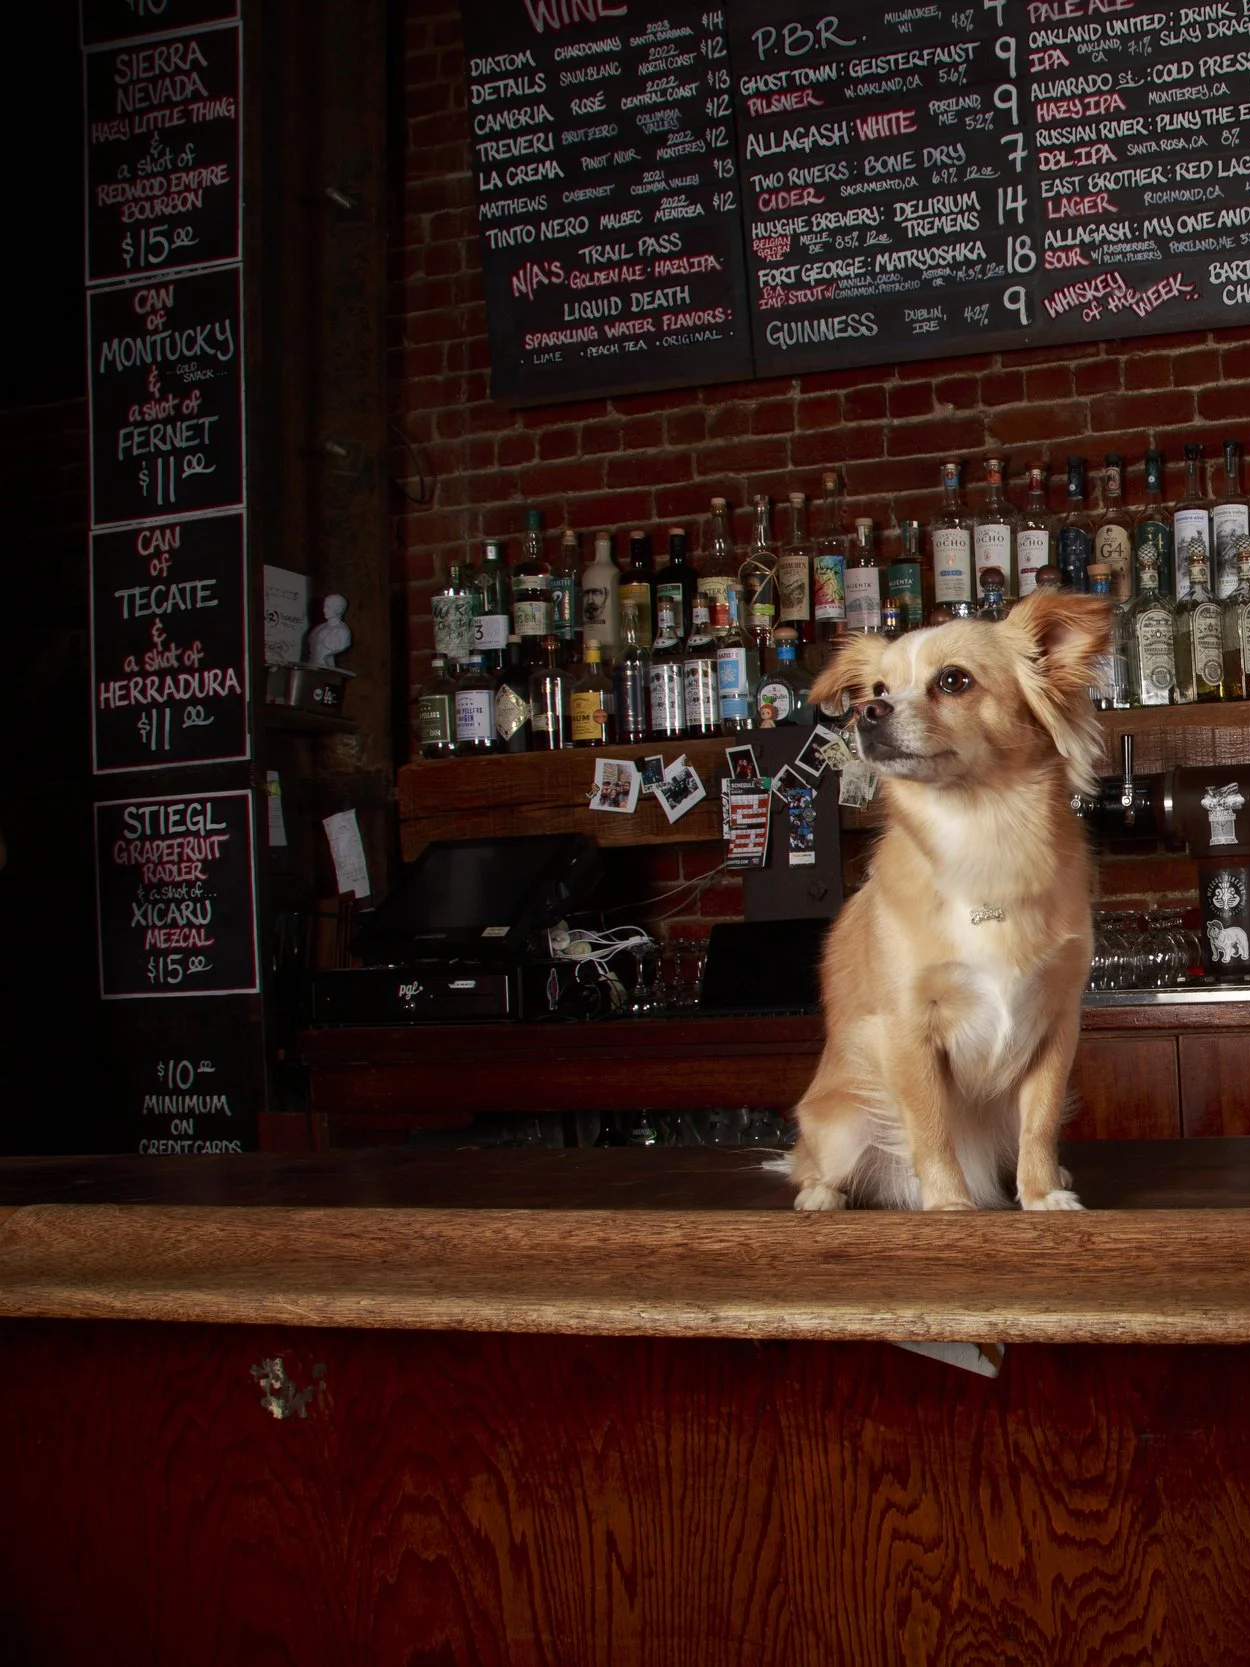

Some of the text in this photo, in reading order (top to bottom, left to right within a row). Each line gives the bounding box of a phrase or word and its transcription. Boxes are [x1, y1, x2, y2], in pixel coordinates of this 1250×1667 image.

[1028, 11, 1166, 49] OAKLAND UNITED
[1159, 26, 1201, 47] SLAY
[114, 42, 208, 84] SIERRA
[470, 49, 536, 78] DIATOM
[850, 41, 981, 78] GEISTERFAUST
[1028, 47, 1070, 73] IPA
[117, 72, 209, 114] NEVADA
[470, 72, 548, 105] DETAILS
[1030, 71, 1113, 102] ALVARADO
[1152, 61, 1195, 84] COLD
[92, 98, 235, 144] HAZY LITTLE THING
[472, 103, 555, 136] CAMBRIA
[854, 109, 918, 142] WHITE
[1202, 104, 1237, 126] THE
[138, 143, 196, 176] shot of
[656, 139, 706, 161] MONTEREY
[479, 148, 642, 192] LA CREMA PINOT NOIR
[750, 142, 967, 192] TWO BONE DRY
[1040, 174, 1087, 199] EAST
[1175, 162, 1214, 181] RED
[97, 164, 230, 207] REDWOOD EMPIRE
[757, 186, 826, 213] CIDER
[122, 190, 204, 223] BOURBON
[478, 194, 548, 222] MATTHEWS
[654, 203, 705, 224] MENDOZA
[751, 190, 981, 240] HUYGHE DELIRIUM
[1047, 192, 1120, 220] LAGER
[485, 209, 644, 250] TINTO NERO MALBEC
[901, 211, 980, 240] TREMENS
[1143, 211, 1217, 239] MY ONE
[578, 232, 683, 267] TRAIL PASS
[757, 240, 988, 289] FORT MATRYOSHKA
[1043, 248, 1090, 270] SOUR
[134, 283, 175, 315] CAN
[563, 284, 691, 322] LIQUID DEATH
[788, 283, 824, 305] STOUT
[1042, 271, 1128, 320] WHISKEY
[146, 310, 168, 329] of
[1082, 304, 1105, 323] of
[99, 318, 235, 374] MONTUCKY
[524, 318, 656, 350] SPARKLING WATER
[766, 311, 880, 351] GUINNESS
[533, 330, 724, 366] LIME TEA ORIGINAL
[143, 390, 203, 422] shot of
[117, 415, 220, 460] FERNET
[137, 526, 181, 557] CAN
[936, 539, 967, 548] OCHO
[1100, 542, 1124, 559] G4
[114, 579, 219, 620] TECATE
[144, 640, 204, 672] shot of
[100, 668, 241, 710] HERRADURA
[123, 802, 227, 840] STIEGL
[113, 833, 230, 865] GRAPEFRUIT
[143, 861, 208, 885] RADLER
[145, 928, 215, 951] MEZCAL
[143, 1094, 231, 1117] MINIMUM
[171, 1117, 194, 1135] ON
[139, 1137, 194, 1155] CREDIT
